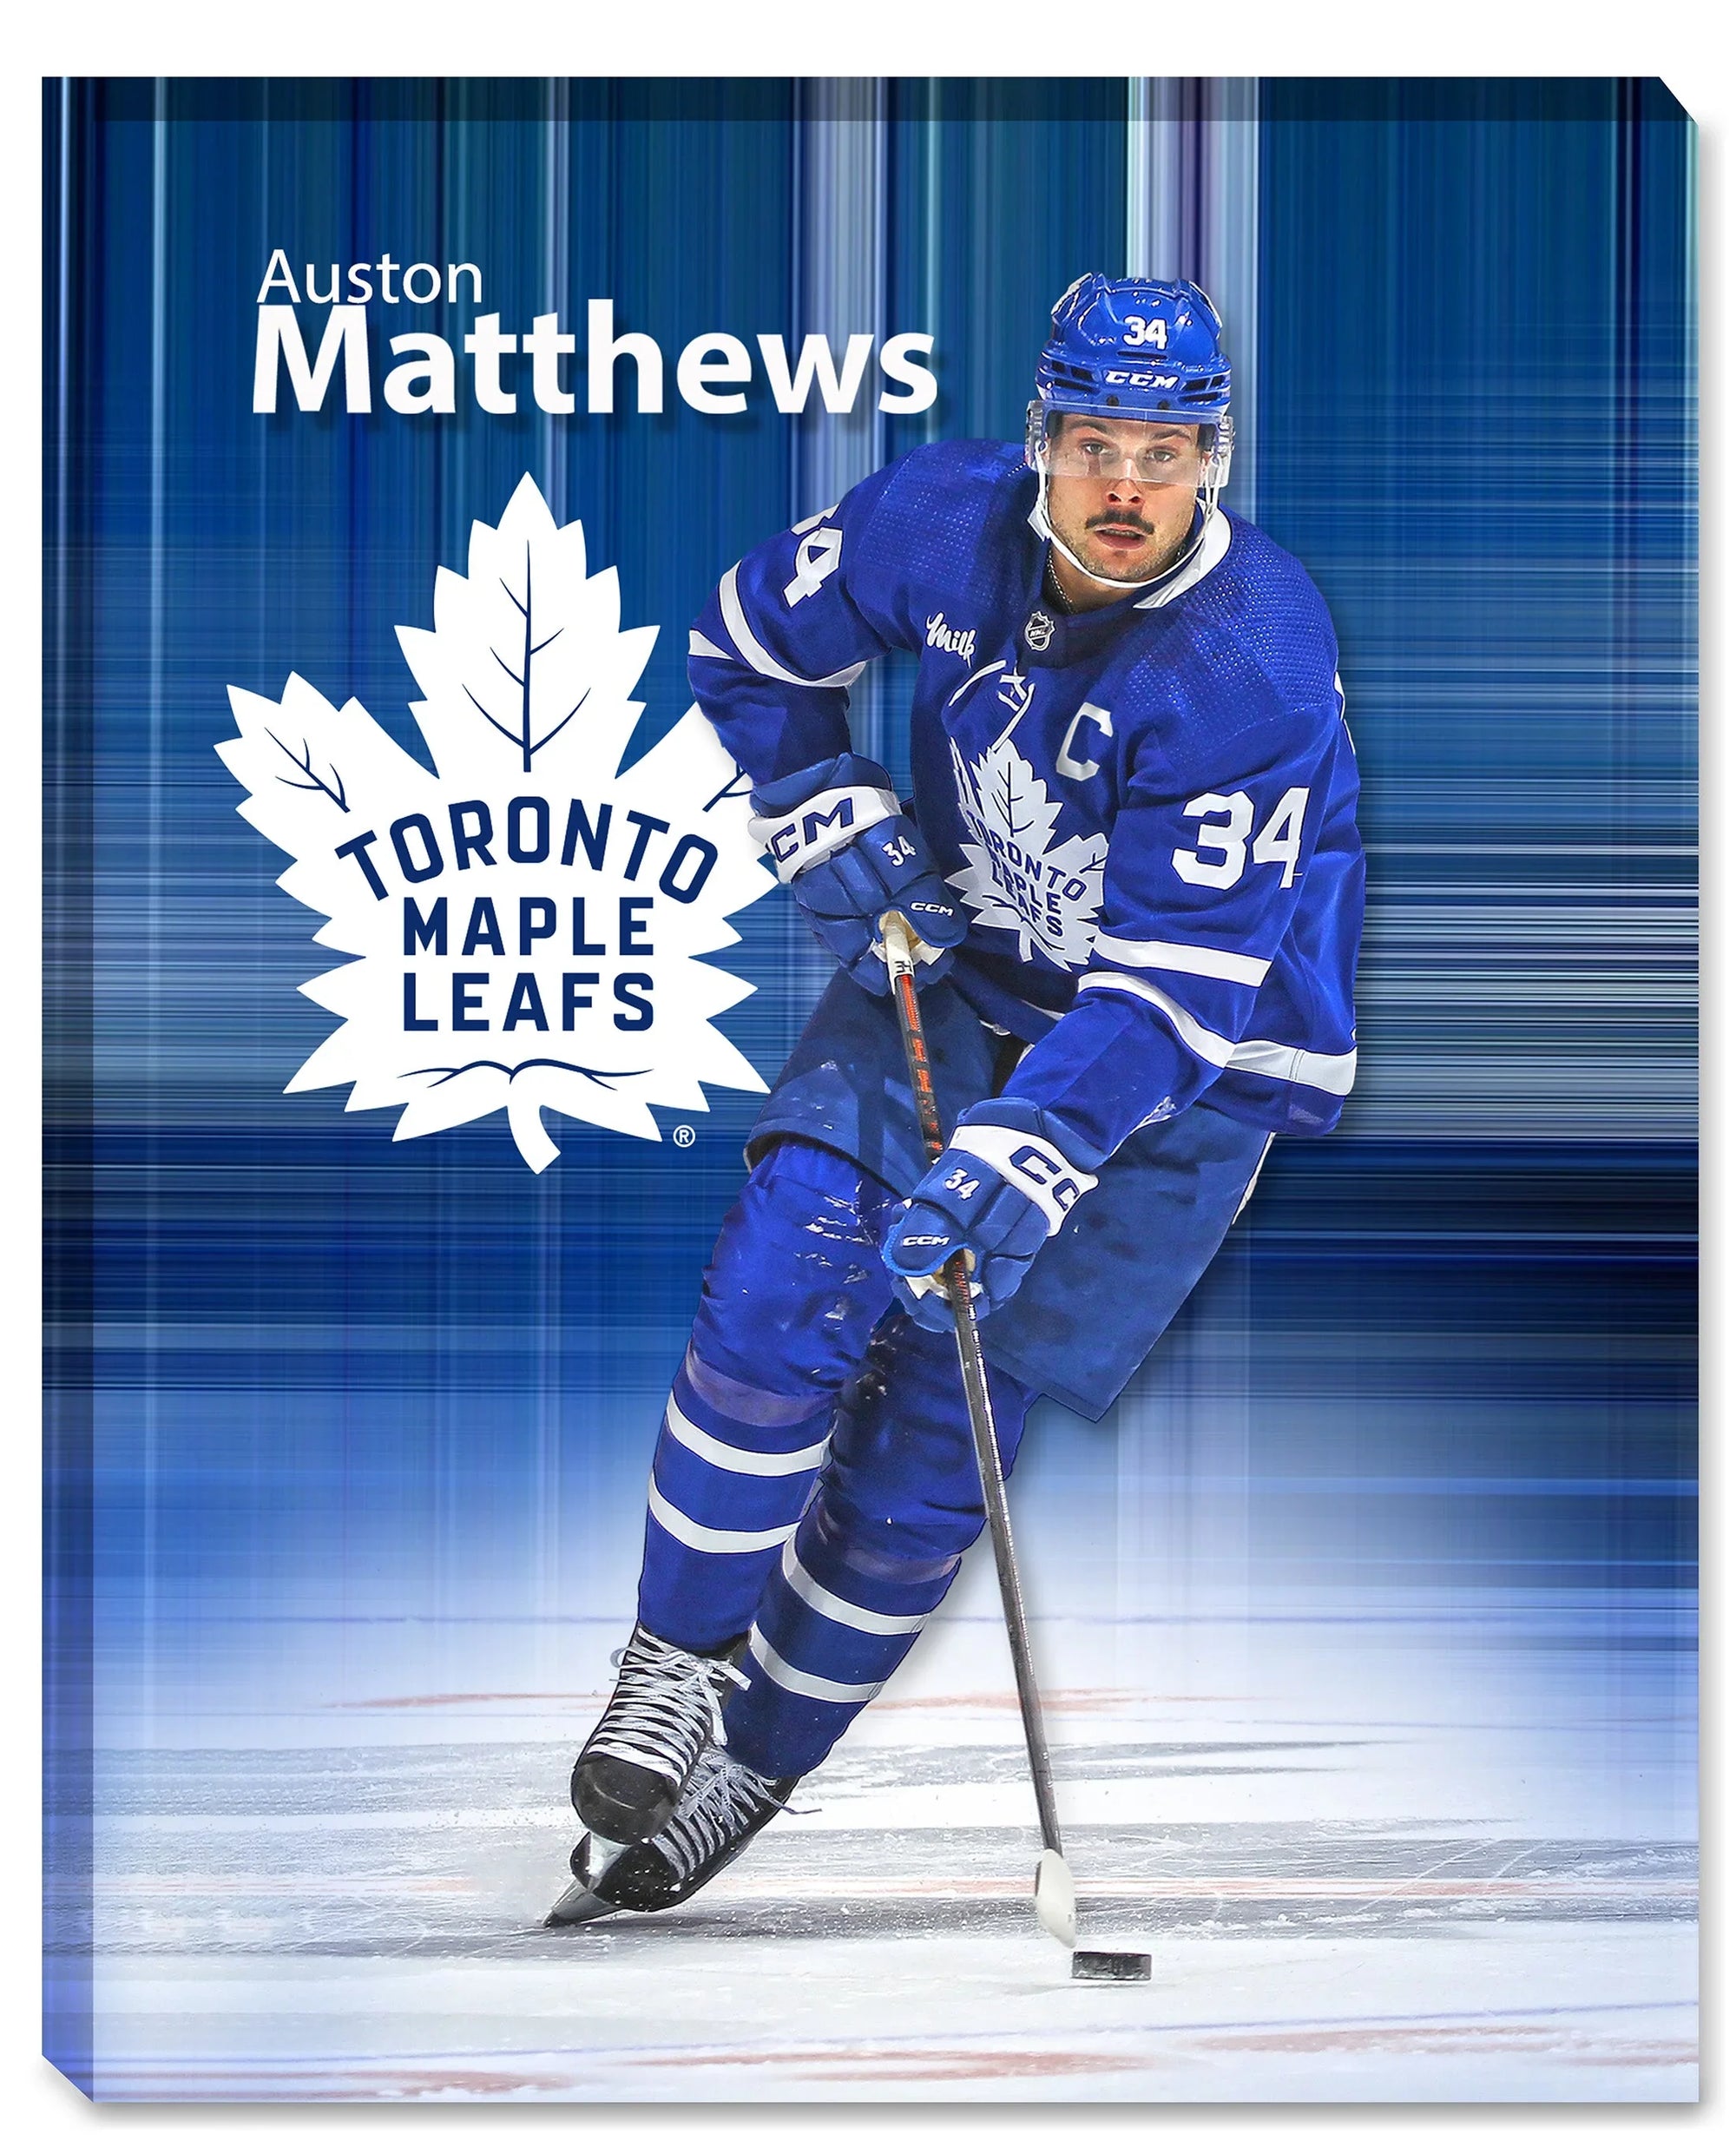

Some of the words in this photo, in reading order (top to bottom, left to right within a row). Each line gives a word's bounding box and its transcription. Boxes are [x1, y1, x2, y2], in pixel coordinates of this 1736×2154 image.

[257, 249, 482, 304] Auston
[253, 299, 938, 414] Matthews
[1122, 316, 1167, 350] 34
[1104, 370, 1180, 389] CCM
[925, 612, 976, 668] Milk
[1056, 702, 1114, 781] C
[334, 796, 718, 904] TORONTO
[766, 797, 854, 862] CM
[882, 836, 917, 866] 34
[1172, 787, 1310, 890] 34
[404, 897, 654, 955] MAPLE
[911, 902, 953, 916] CCM
[404, 972, 654, 1031] LEAFS
[945, 1169, 980, 1200] 34
[902, 1235, 950, 1248] CCM
